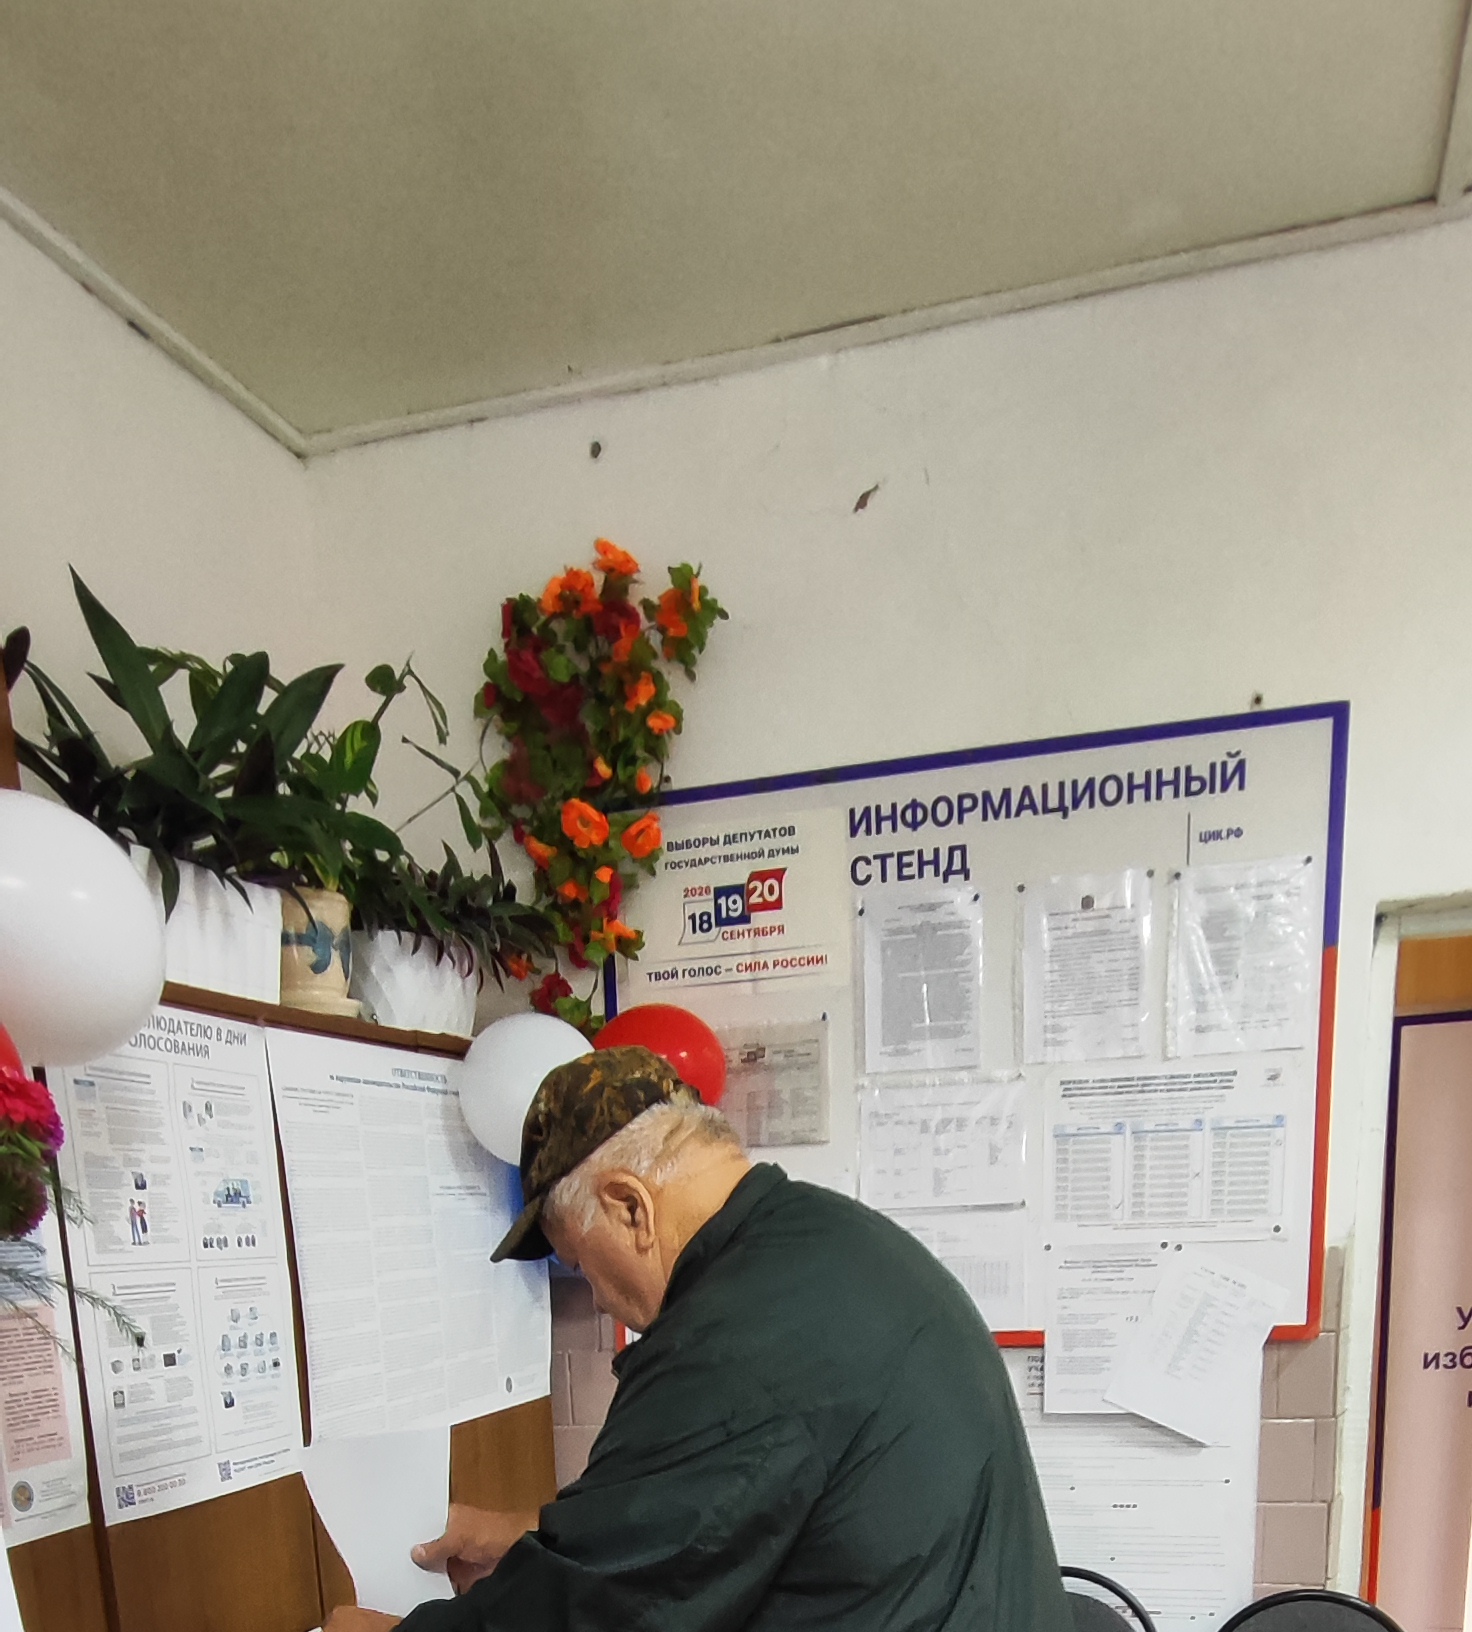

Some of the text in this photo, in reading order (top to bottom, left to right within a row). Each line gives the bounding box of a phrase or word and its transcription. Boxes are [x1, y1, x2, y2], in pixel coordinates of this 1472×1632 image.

[849, 750, 1247, 838] ИНФОРМАЦИОННЫЙ
[666, 825, 796, 852] ВЫБОРЫ ДЕПУТАТОВ
[1199, 826, 1244, 844] ЦИК.РФ
[665, 845, 800, 870] ГОСУДАРСТВЕННОЙ ДУМЫ
[850, 844, 970, 886] СТЕНД
[688, 878, 779, 934] 18 19 20
[721, 924, 785, 941] СЕНТЯБРЯ
[646, 966, 679, 983] ТВОЙ
[682, 965, 722, 979] ГОЛОС
[735, 960, 770, 974] СИЛА
[773, 954, 828, 969] РОССИИ!
[147, 1014, 247, 1046] ЛЮДАТЕЛЮ В ДНИ
